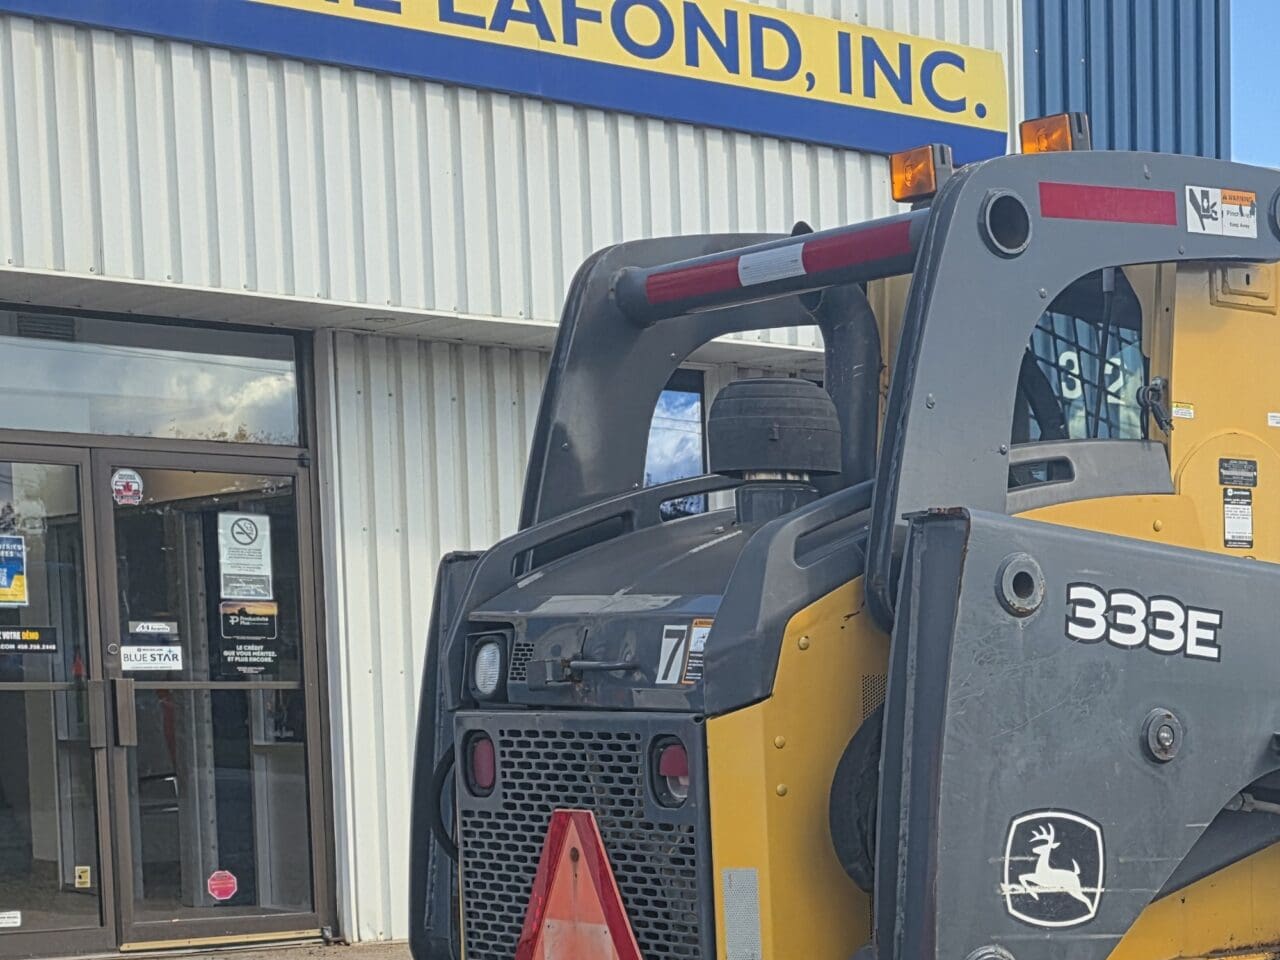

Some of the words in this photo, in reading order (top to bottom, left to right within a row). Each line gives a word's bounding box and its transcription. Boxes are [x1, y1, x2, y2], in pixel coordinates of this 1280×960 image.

[837, 30, 987, 119] INC.
[1067, 585, 1221, 659] 333E
[123, 654, 148, 662] BLUE
[150, 653, 179, 662] STAR
[661, 629, 687, 681] 7
